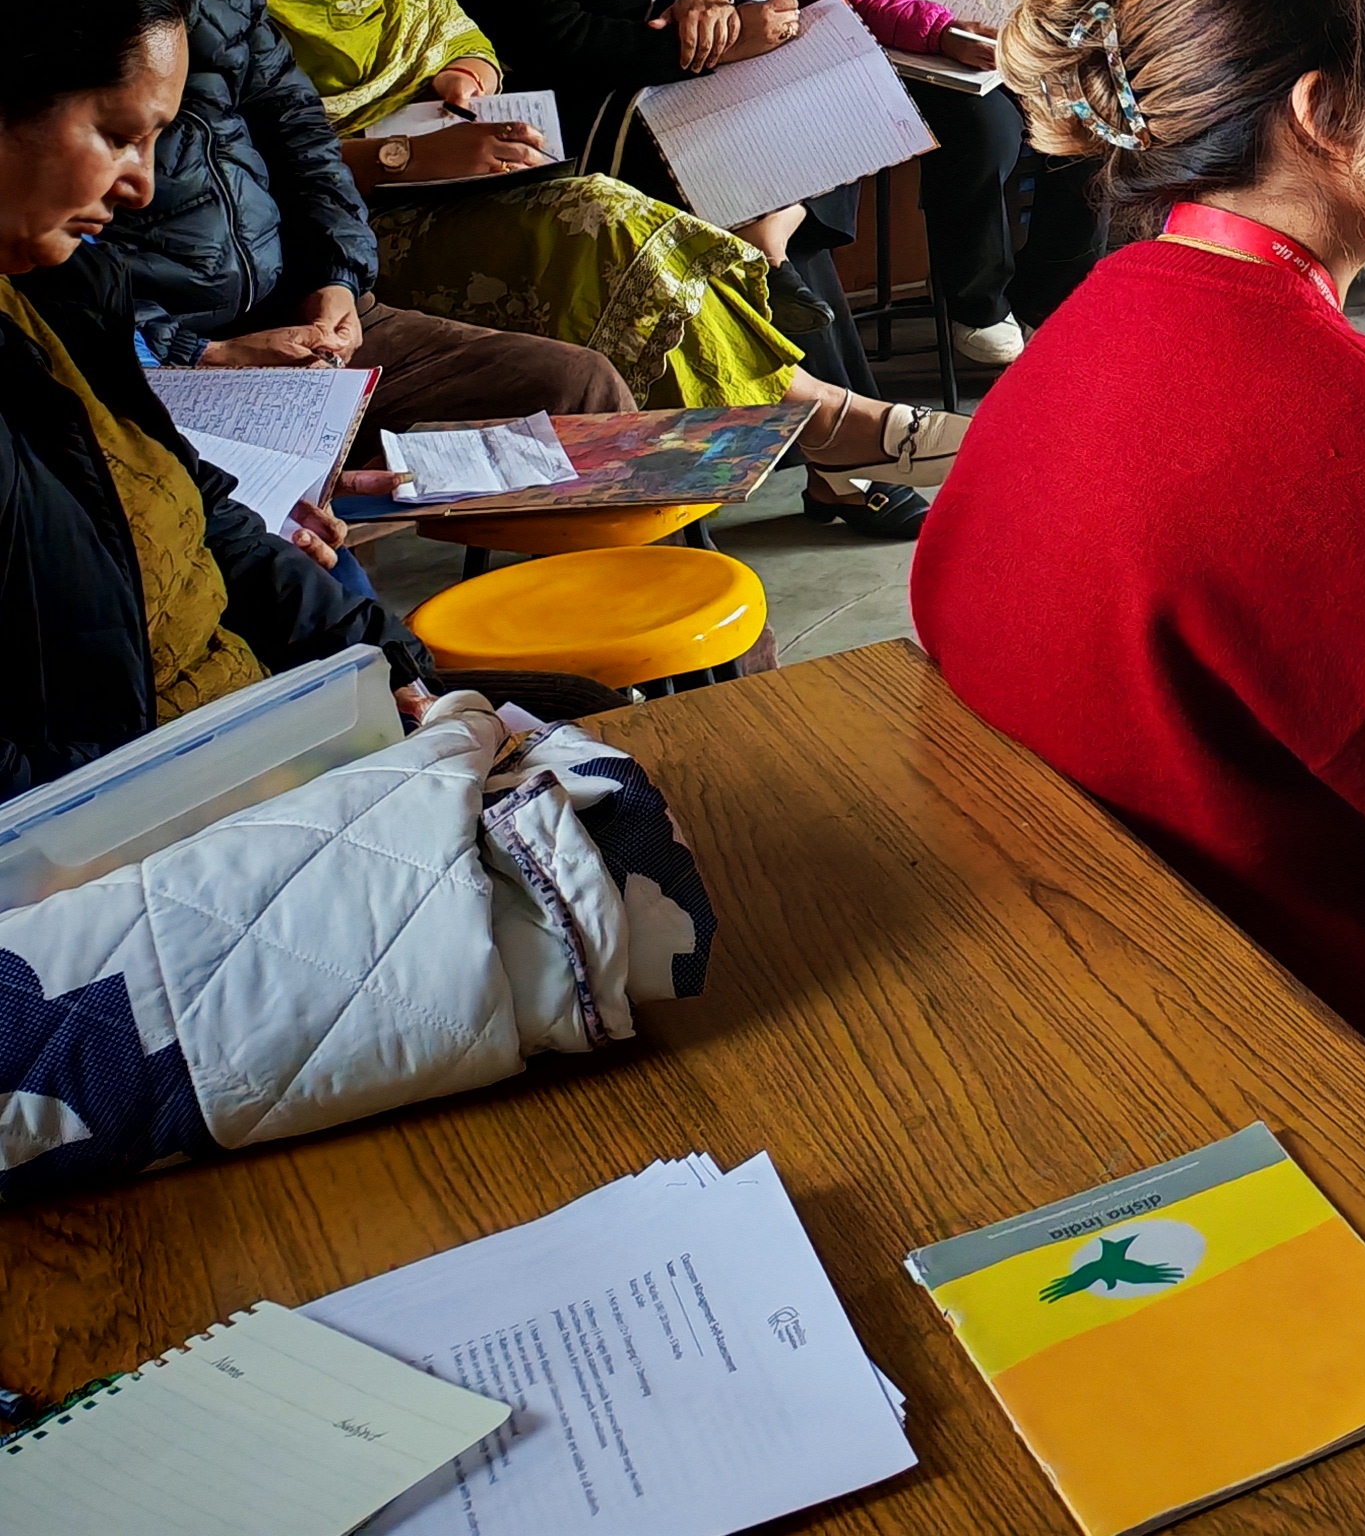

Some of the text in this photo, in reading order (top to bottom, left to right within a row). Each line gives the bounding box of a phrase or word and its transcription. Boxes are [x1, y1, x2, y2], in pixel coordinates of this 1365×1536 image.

[1293, 257, 1310, 272] for
[1106, 1193, 1163, 1221] disha
[1048, 1216, 1104, 1240] india
